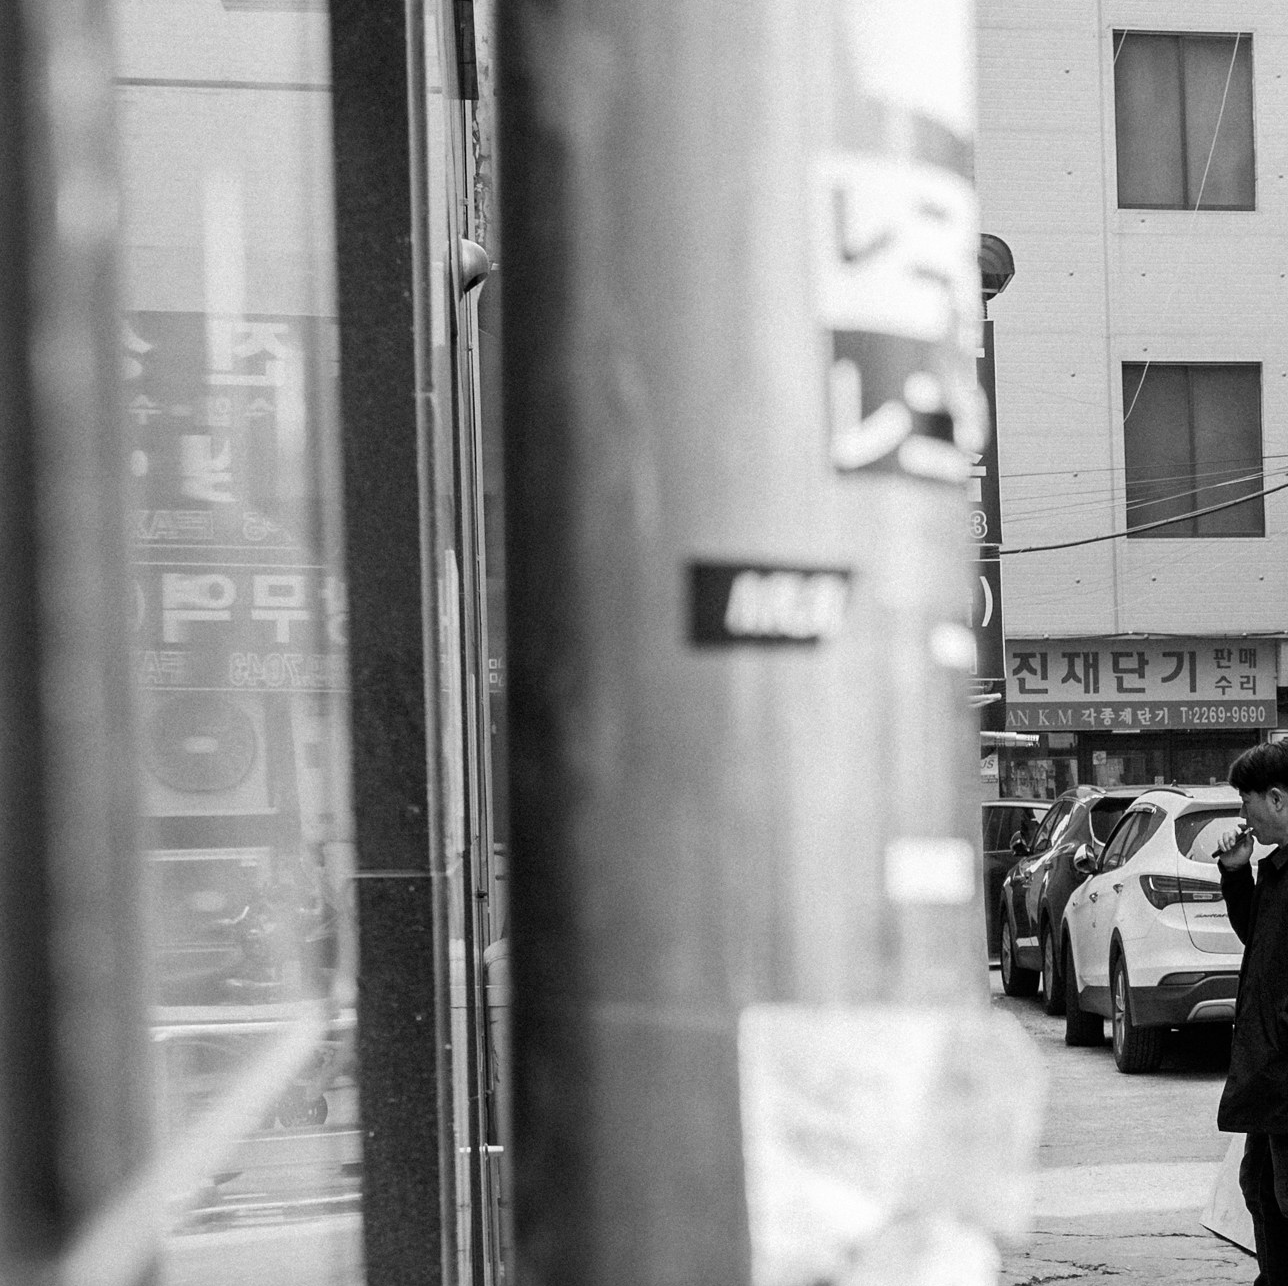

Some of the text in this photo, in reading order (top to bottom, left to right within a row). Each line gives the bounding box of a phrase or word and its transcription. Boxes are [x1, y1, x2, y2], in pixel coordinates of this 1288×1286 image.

[1213, 648, 1257, 669] 판매
[1012, 651, 1197, 695] 진재단기
[1214, 675, 1257, 696] 수리
[1180, 705, 1266, 723] T:2269-9690
